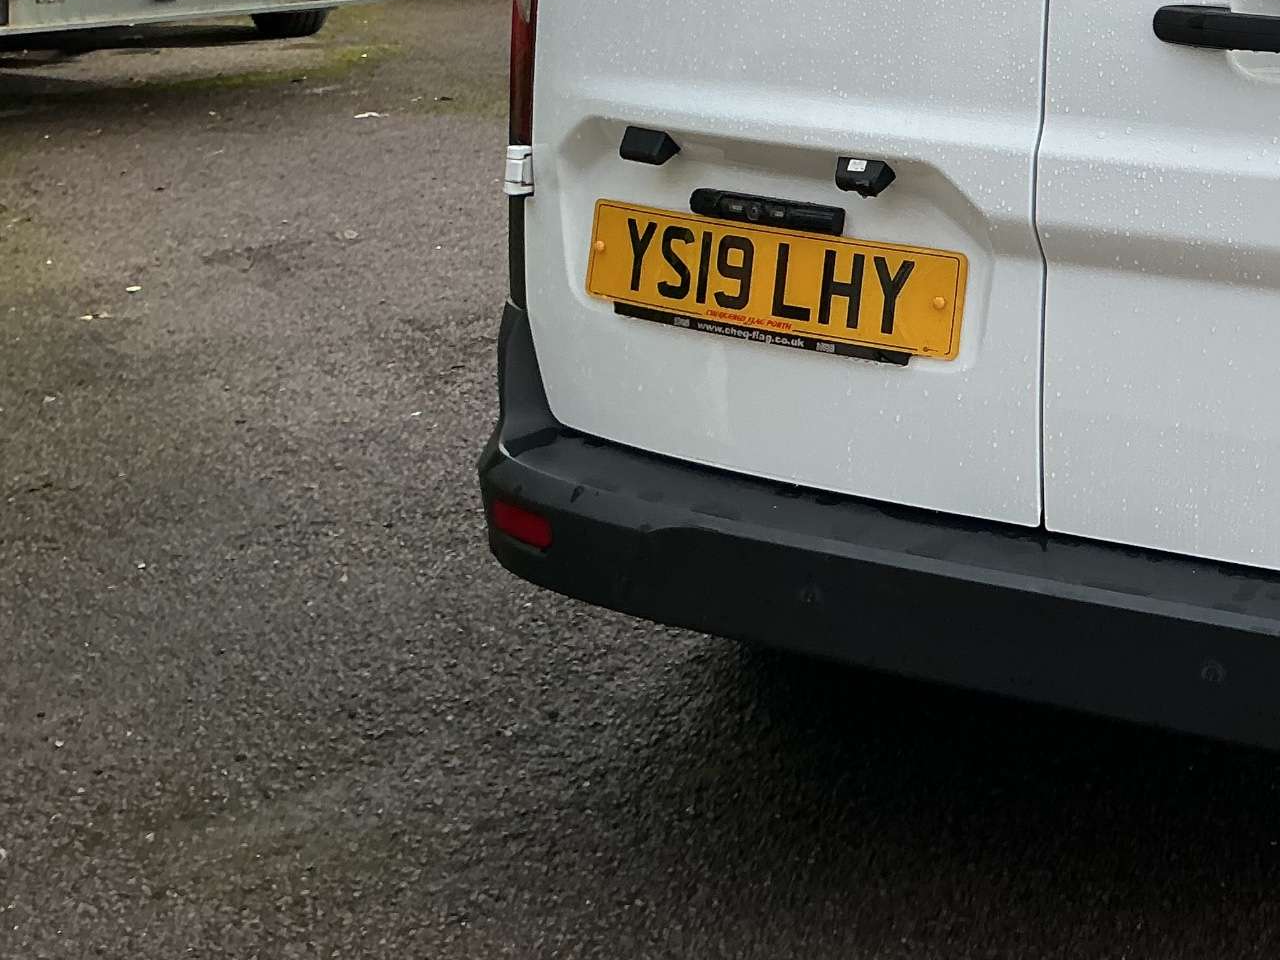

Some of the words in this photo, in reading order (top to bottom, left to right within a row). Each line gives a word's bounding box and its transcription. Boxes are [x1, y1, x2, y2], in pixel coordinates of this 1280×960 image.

[627, 218, 755, 310] YS19
[771, 243, 916, 335] LHY
[697, 322, 805, 348] www.cheq-flag.co.uk
